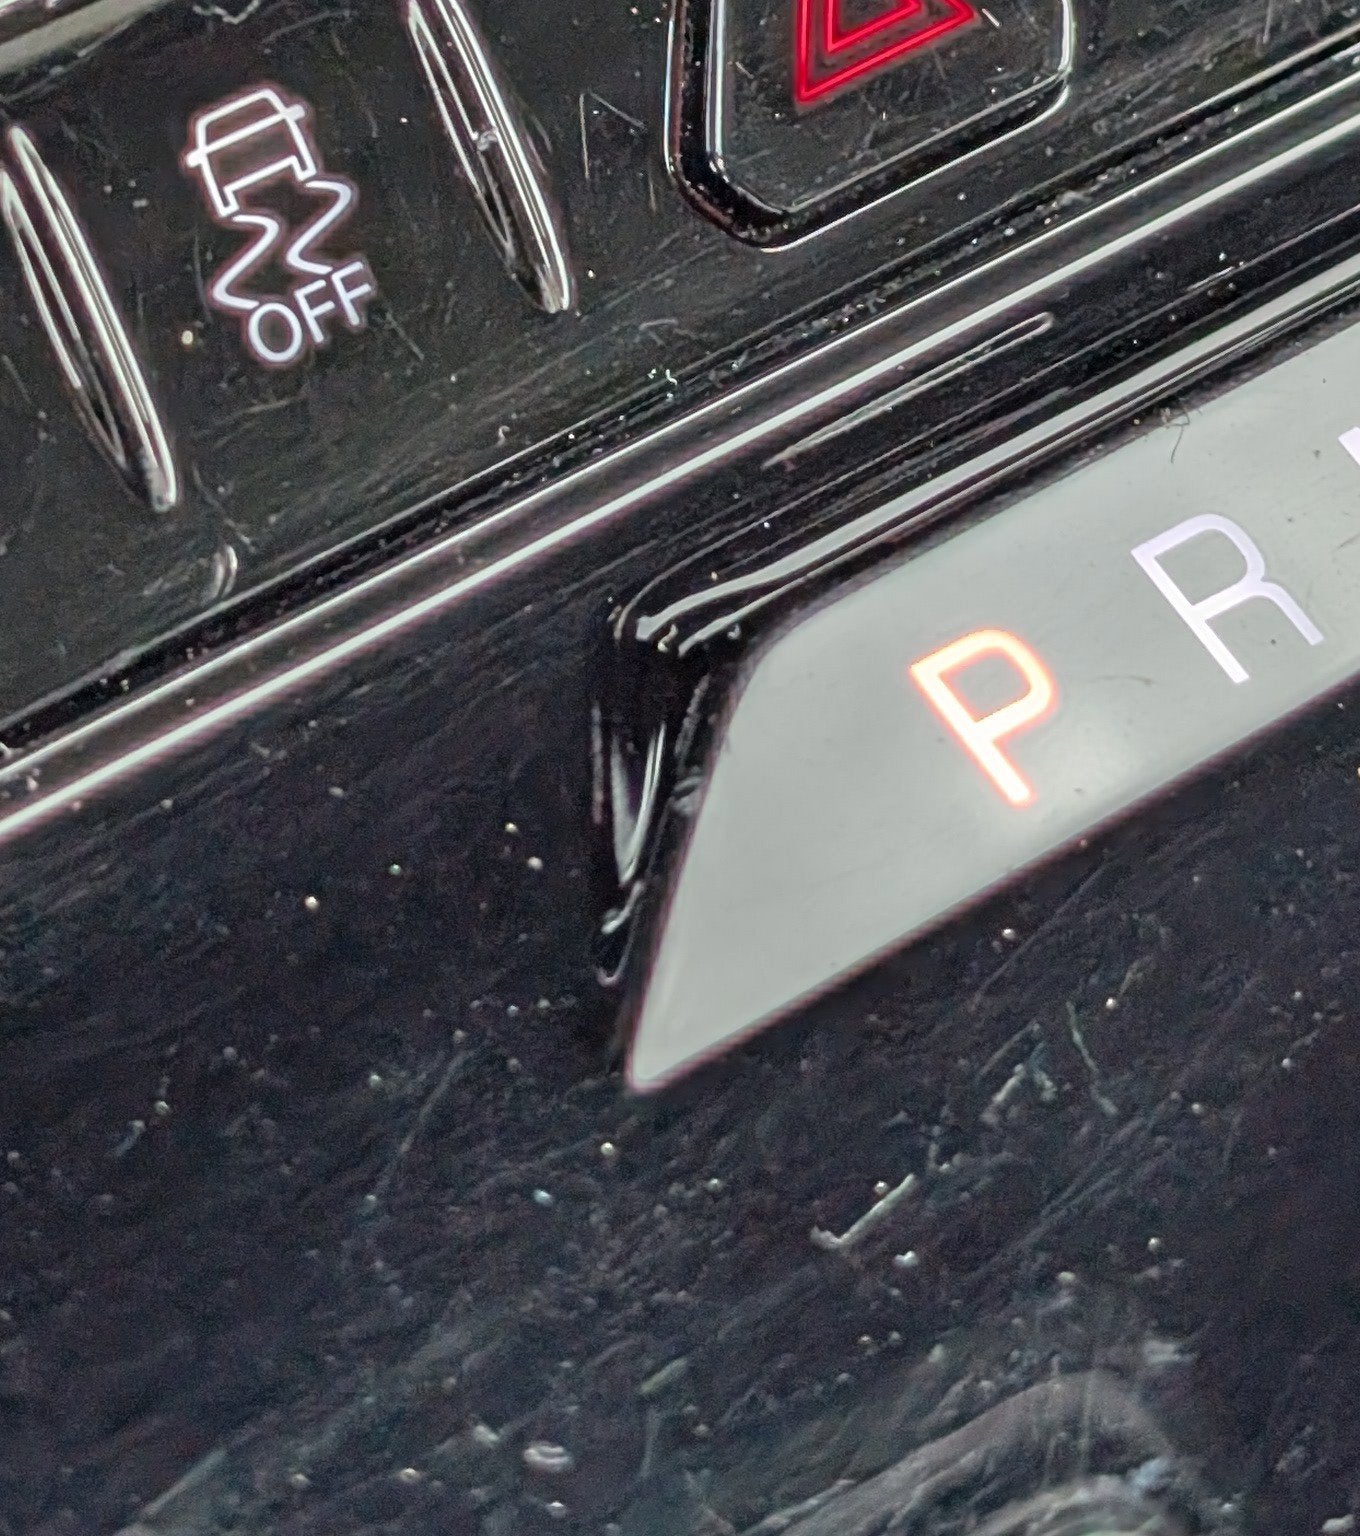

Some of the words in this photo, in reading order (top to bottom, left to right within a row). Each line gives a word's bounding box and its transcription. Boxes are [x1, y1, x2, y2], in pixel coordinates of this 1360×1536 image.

[248, 261, 373, 362] OFF
[910, 628, 1059, 808] P
[1130, 513, 1325, 685] R
